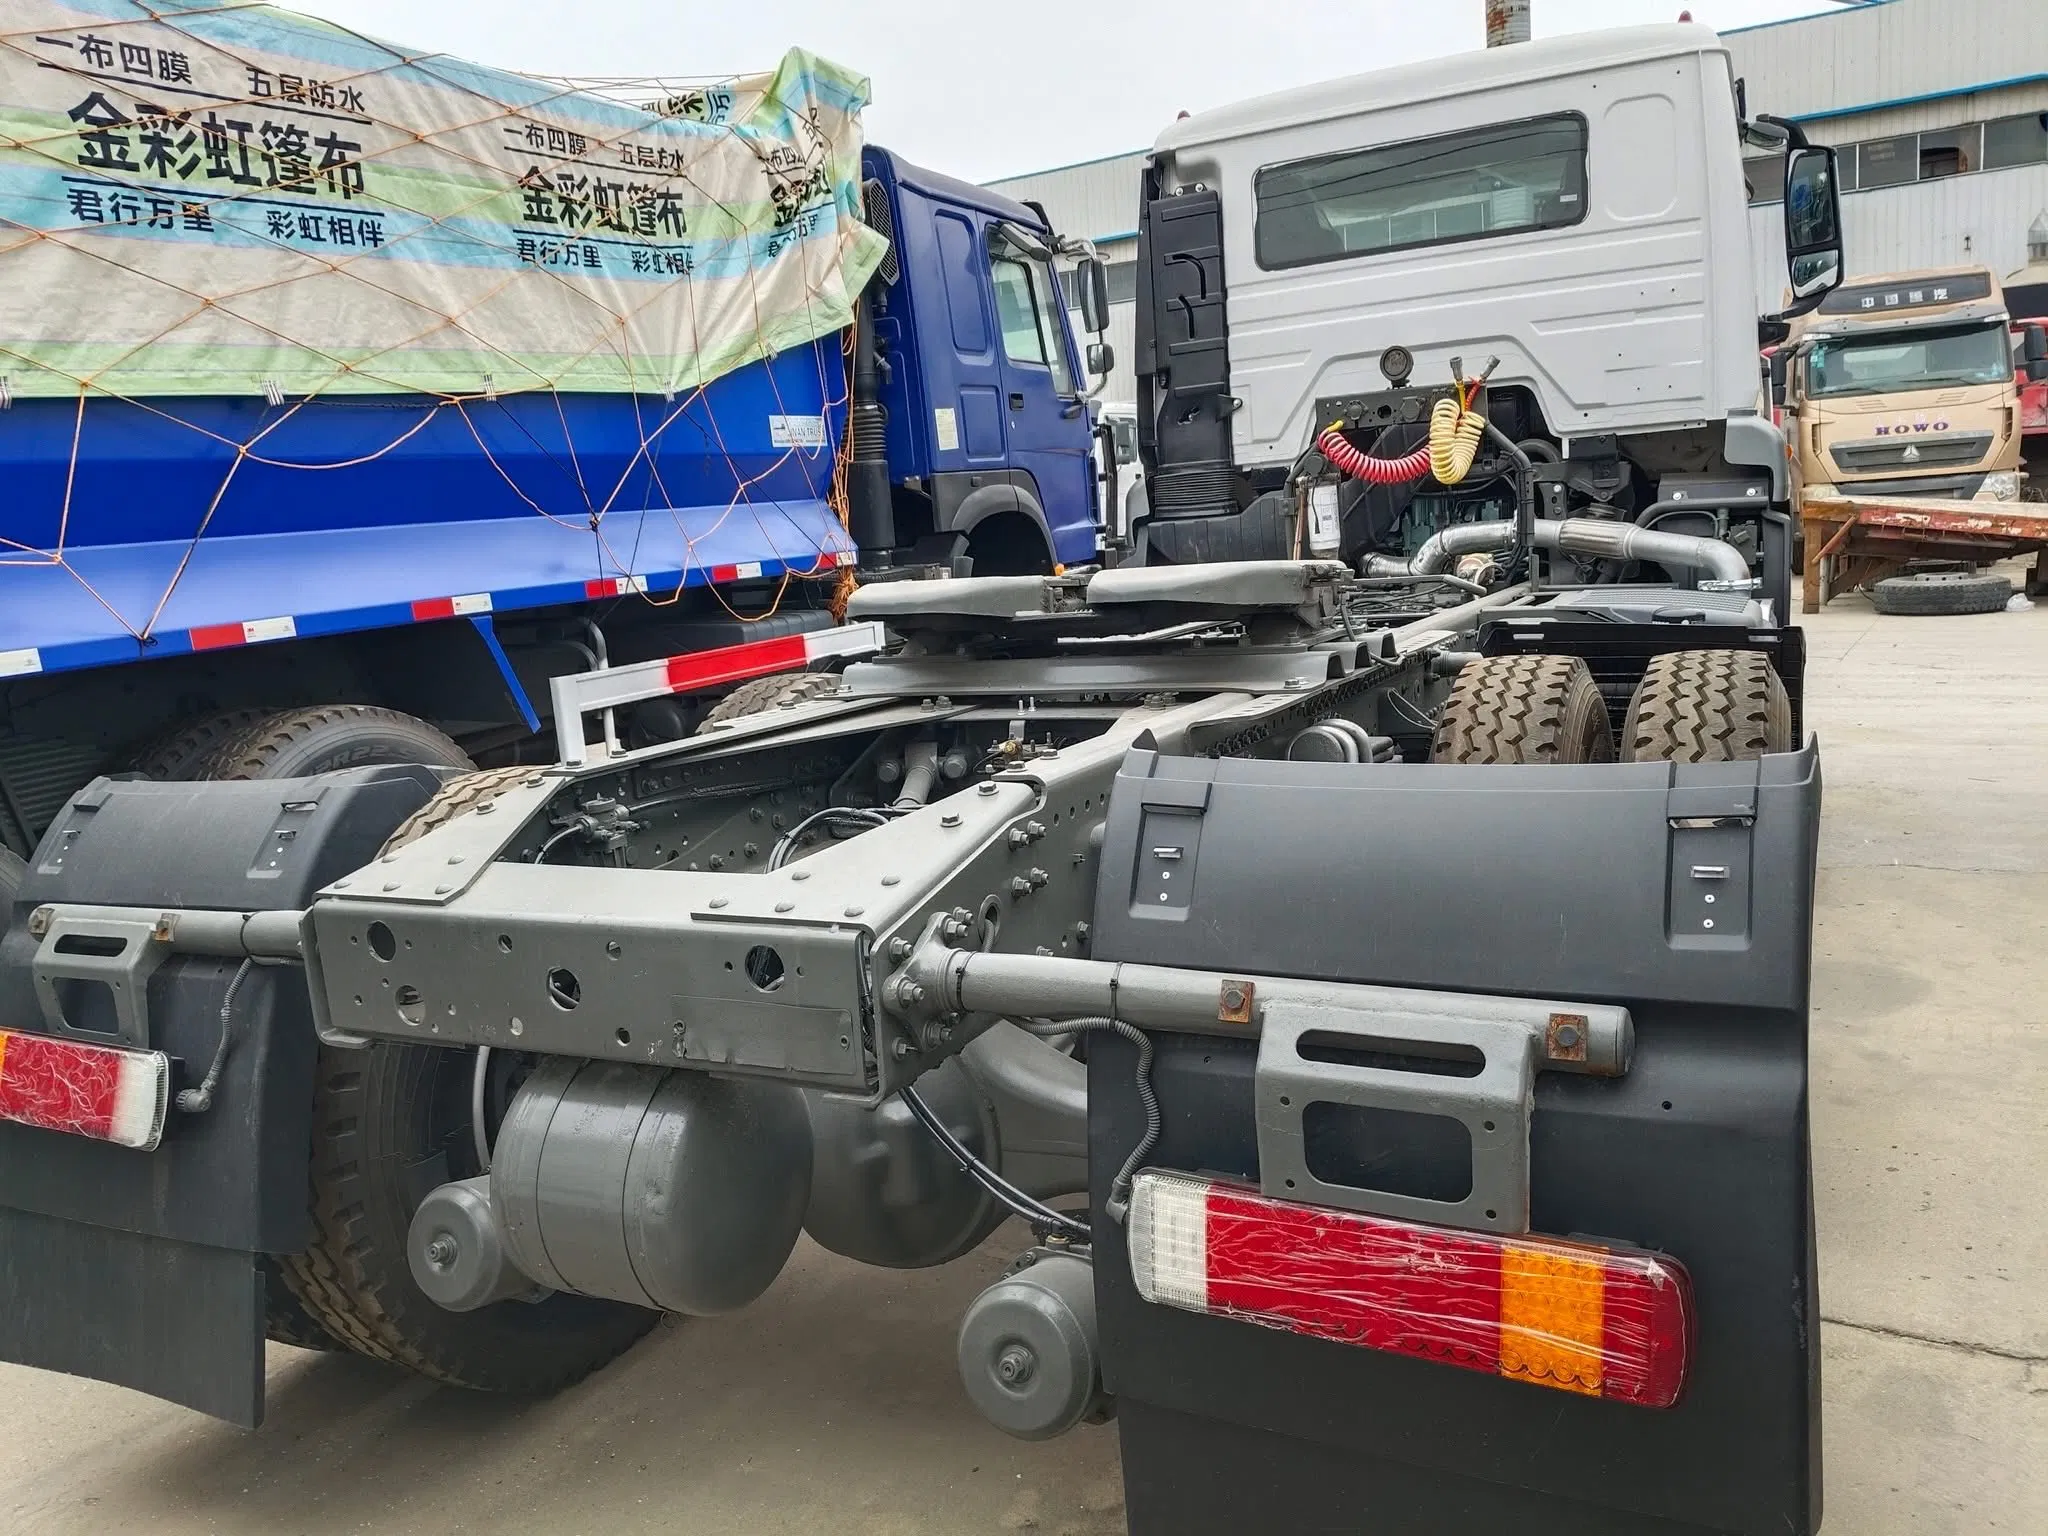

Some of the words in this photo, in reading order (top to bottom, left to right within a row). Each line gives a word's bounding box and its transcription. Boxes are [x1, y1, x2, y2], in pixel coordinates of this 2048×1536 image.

[36, 34, 193, 85] 一布四膜
[246, 66, 366, 113] 五层防水
[67, 91, 366, 200] 金彩虹篷布
[503, 123, 588, 156] 一布四膜
[66, 188, 215, 233] 君行万里
[266, 210, 386, 248] 彩虹相伴
[516, 238, 603, 268] 君行万里
[1875, 422, 1949, 435] HOWO
